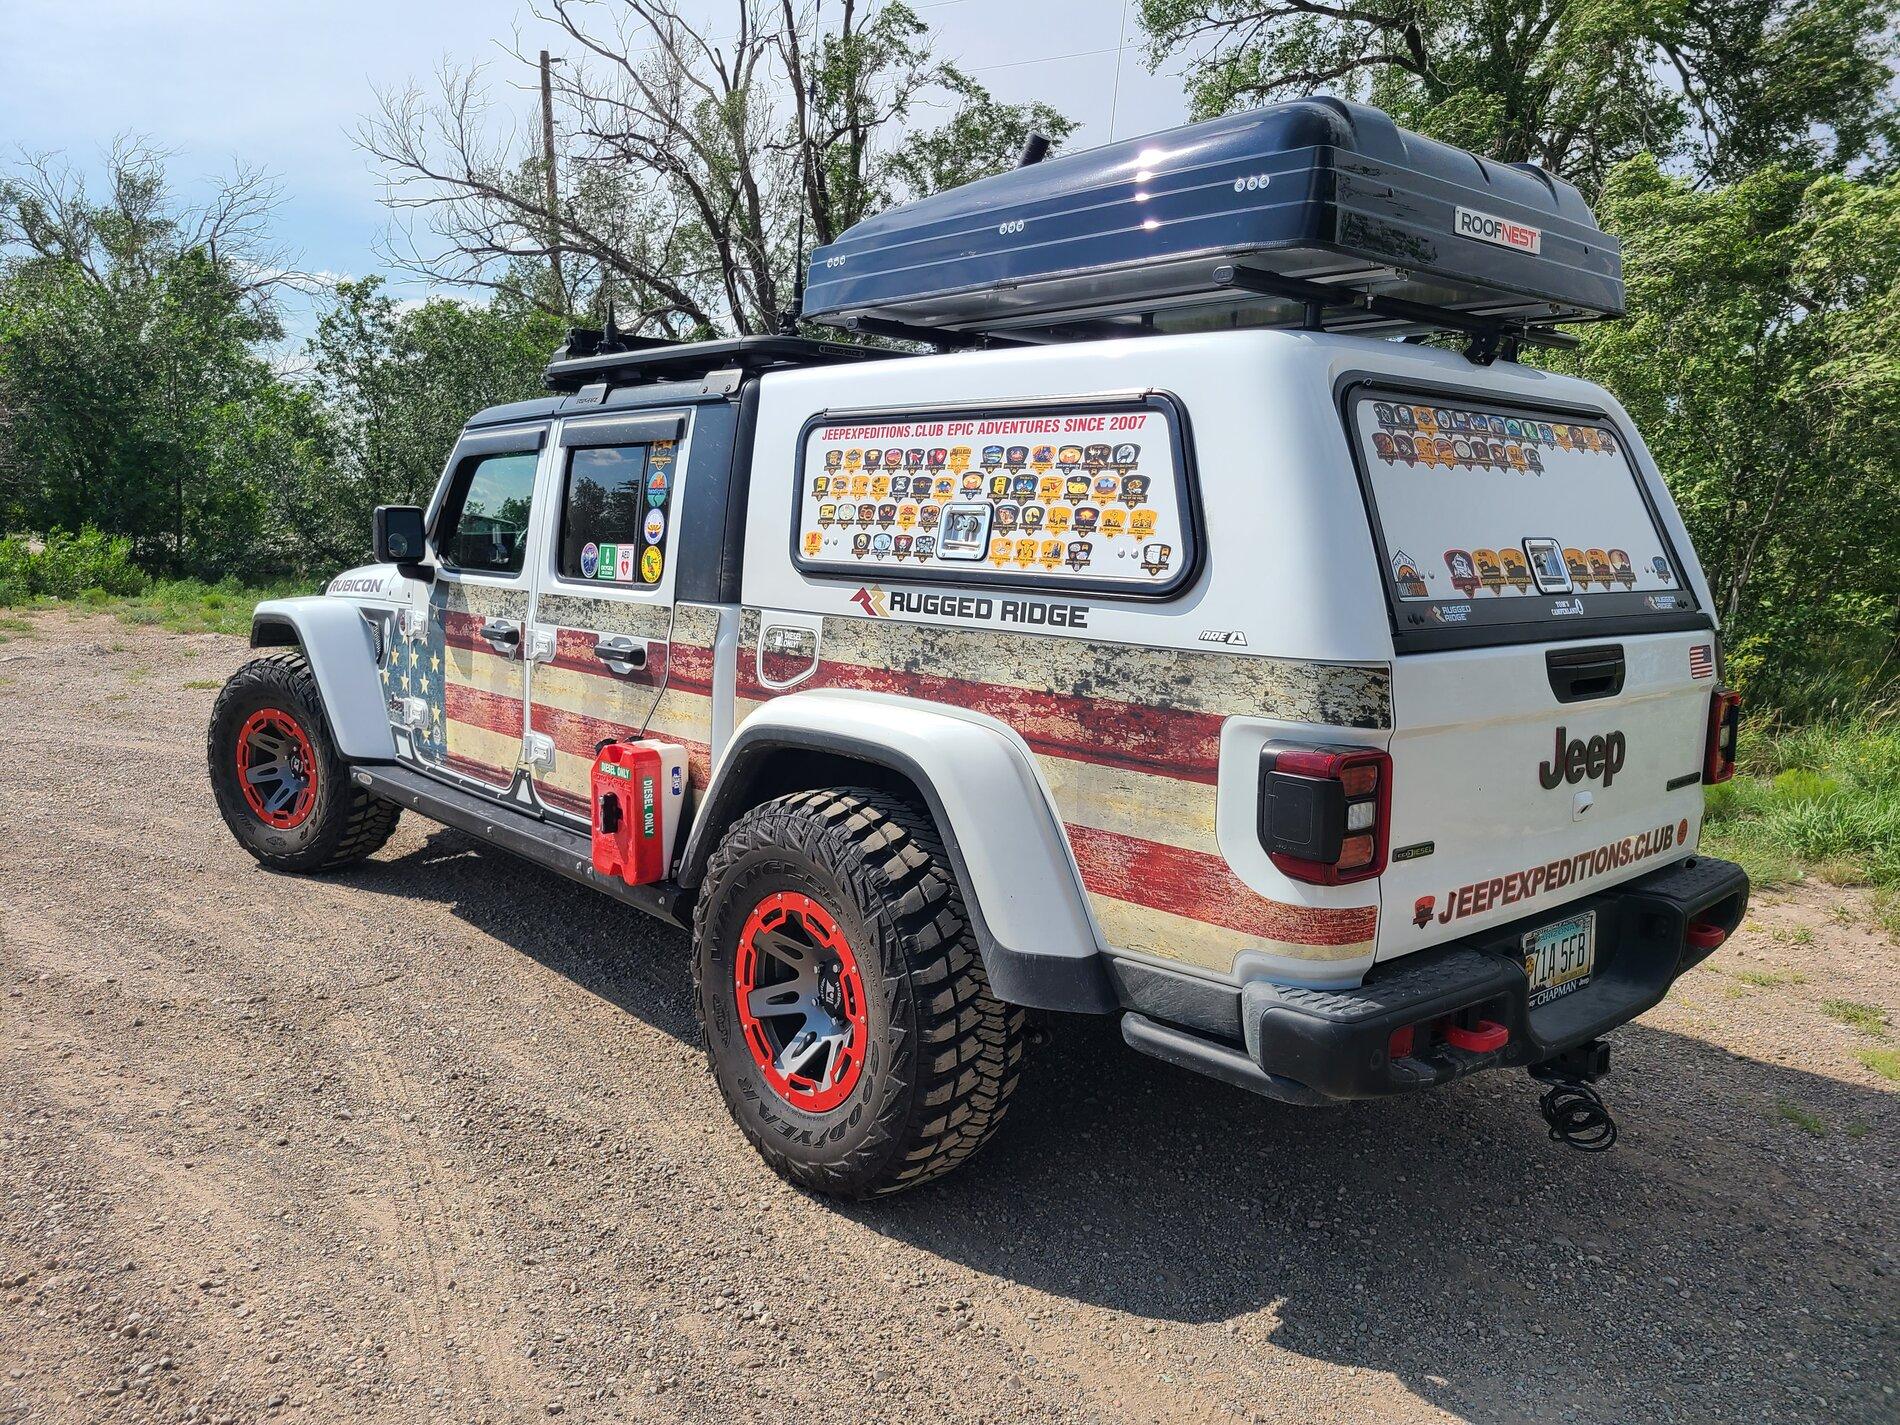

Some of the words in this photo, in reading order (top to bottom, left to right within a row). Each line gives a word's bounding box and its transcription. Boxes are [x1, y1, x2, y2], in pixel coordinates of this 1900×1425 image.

[1461, 212, 1537, 249] ROOFNEST
[822, 424, 944, 441] JEEPEXPEDITIONS.CLUB
[947, 422, 974, 436] EPIC
[977, 418, 1061, 435] ADVENTURES
[1064, 416, 1106, 432] SINCE
[1109, 415, 1147, 430] 2007
[329, 578, 385, 593] RUBICON
[889, 591, 993, 620] RUGGED
[1000, 600, 1090, 628] RIDGE
[1442, 605, 1471, 614] RUGGED
[1445, 613, 1467, 622] RIDGE
[784, 631, 801, 640] DIESEL
[601, 761, 616, 775] DIESEL
[617, 766, 631, 779] ONLY
[1539, 726, 1626, 790] Jeep
[643, 780, 654, 809] DIESEL
[644, 812, 654, 835] ONLY
[1438, 823, 1675, 925] JEEPEXPEDITIONS.CLUB
[1540, 922, 1577, 941] ARIZONA
[1537, 980, 1577, 1005] CHAPMAN
[737, 1040, 880, 1150] GOODYEAR
